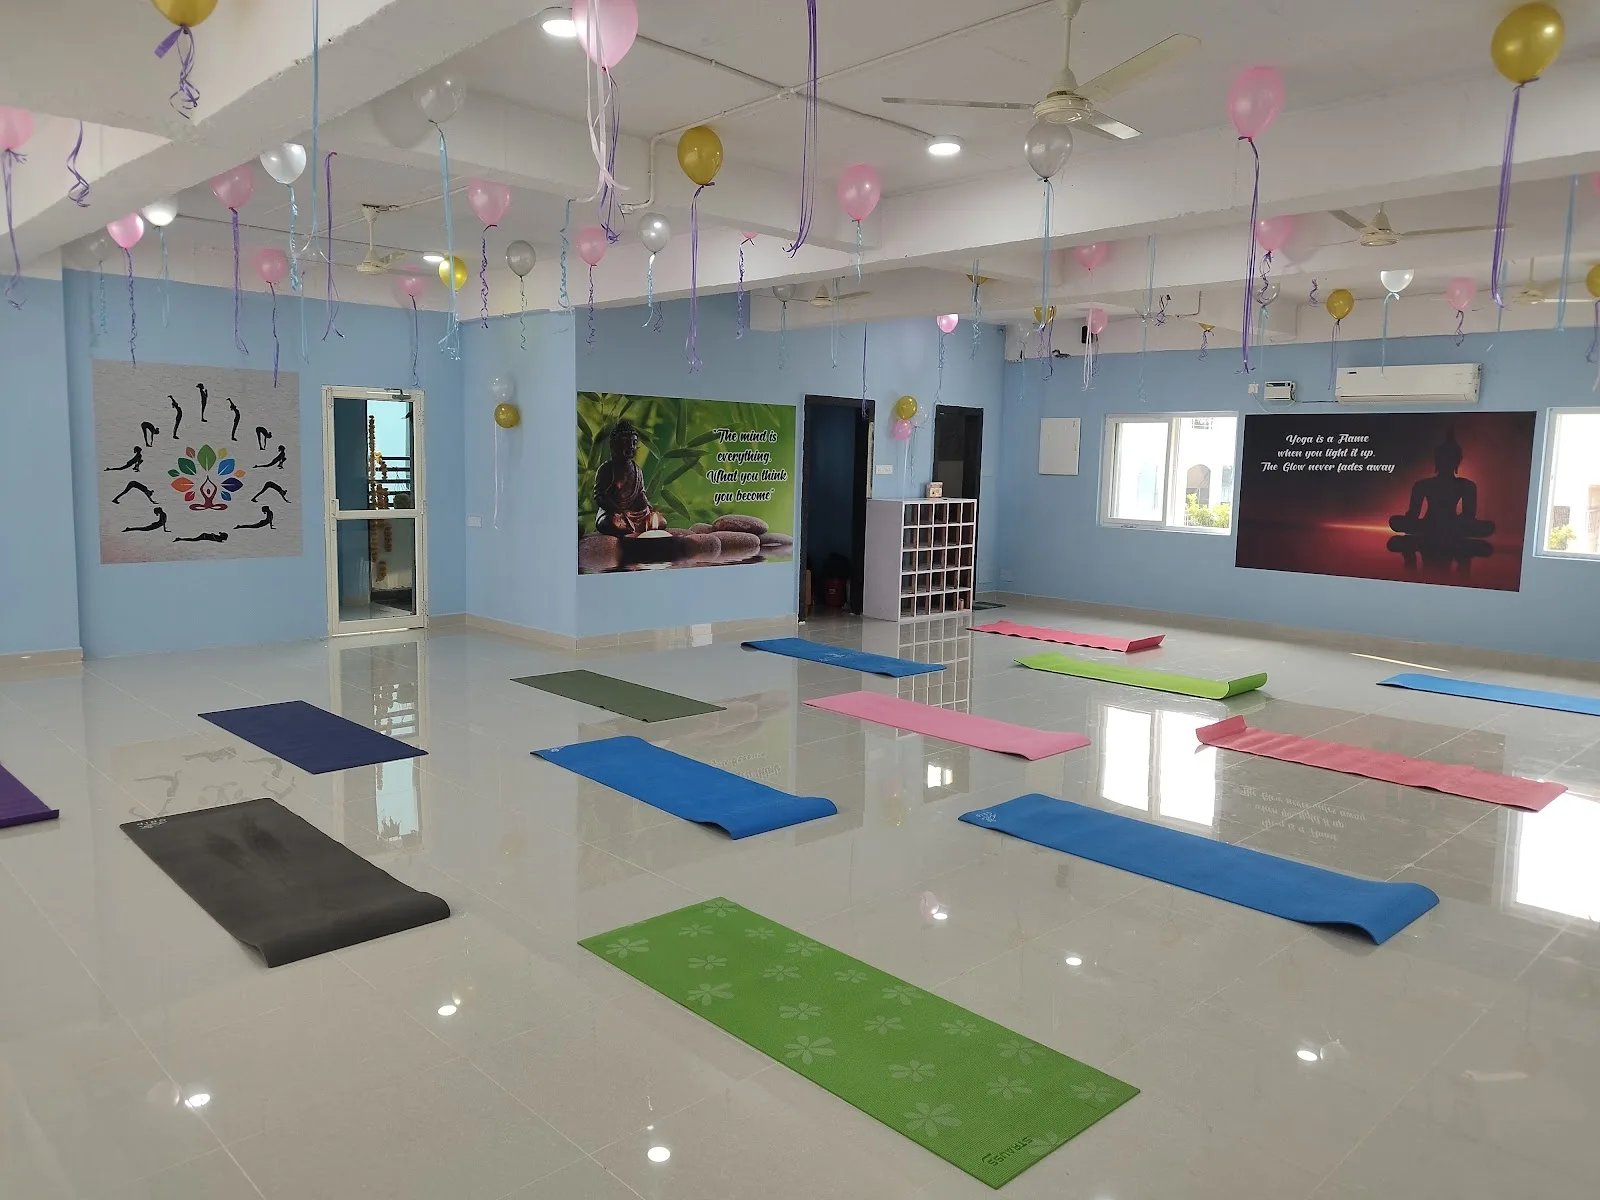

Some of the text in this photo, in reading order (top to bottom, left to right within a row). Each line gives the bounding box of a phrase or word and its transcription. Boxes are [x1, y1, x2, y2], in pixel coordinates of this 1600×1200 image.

[739, 430, 768, 443] mind
[769, 431, 778, 443] is
[1286, 434, 1313, 445] Yoga
[1316, 435, 1324, 443] is
[1337, 434, 1370, 444] Flame
[717, 449, 772, 465] everything.
[1277, 449, 1376, 460] when you light it up.
[1260, 462, 1278, 472] The
[1282, 462, 1306, 473] Glow
[1337, 463, 1364, 473] fades
[1366, 464, 1396, 474] away
[706, 469, 788, 485] What you think
[714, 492, 733, 506] you
[987, 1136, 1033, 1167] STRAUSS
